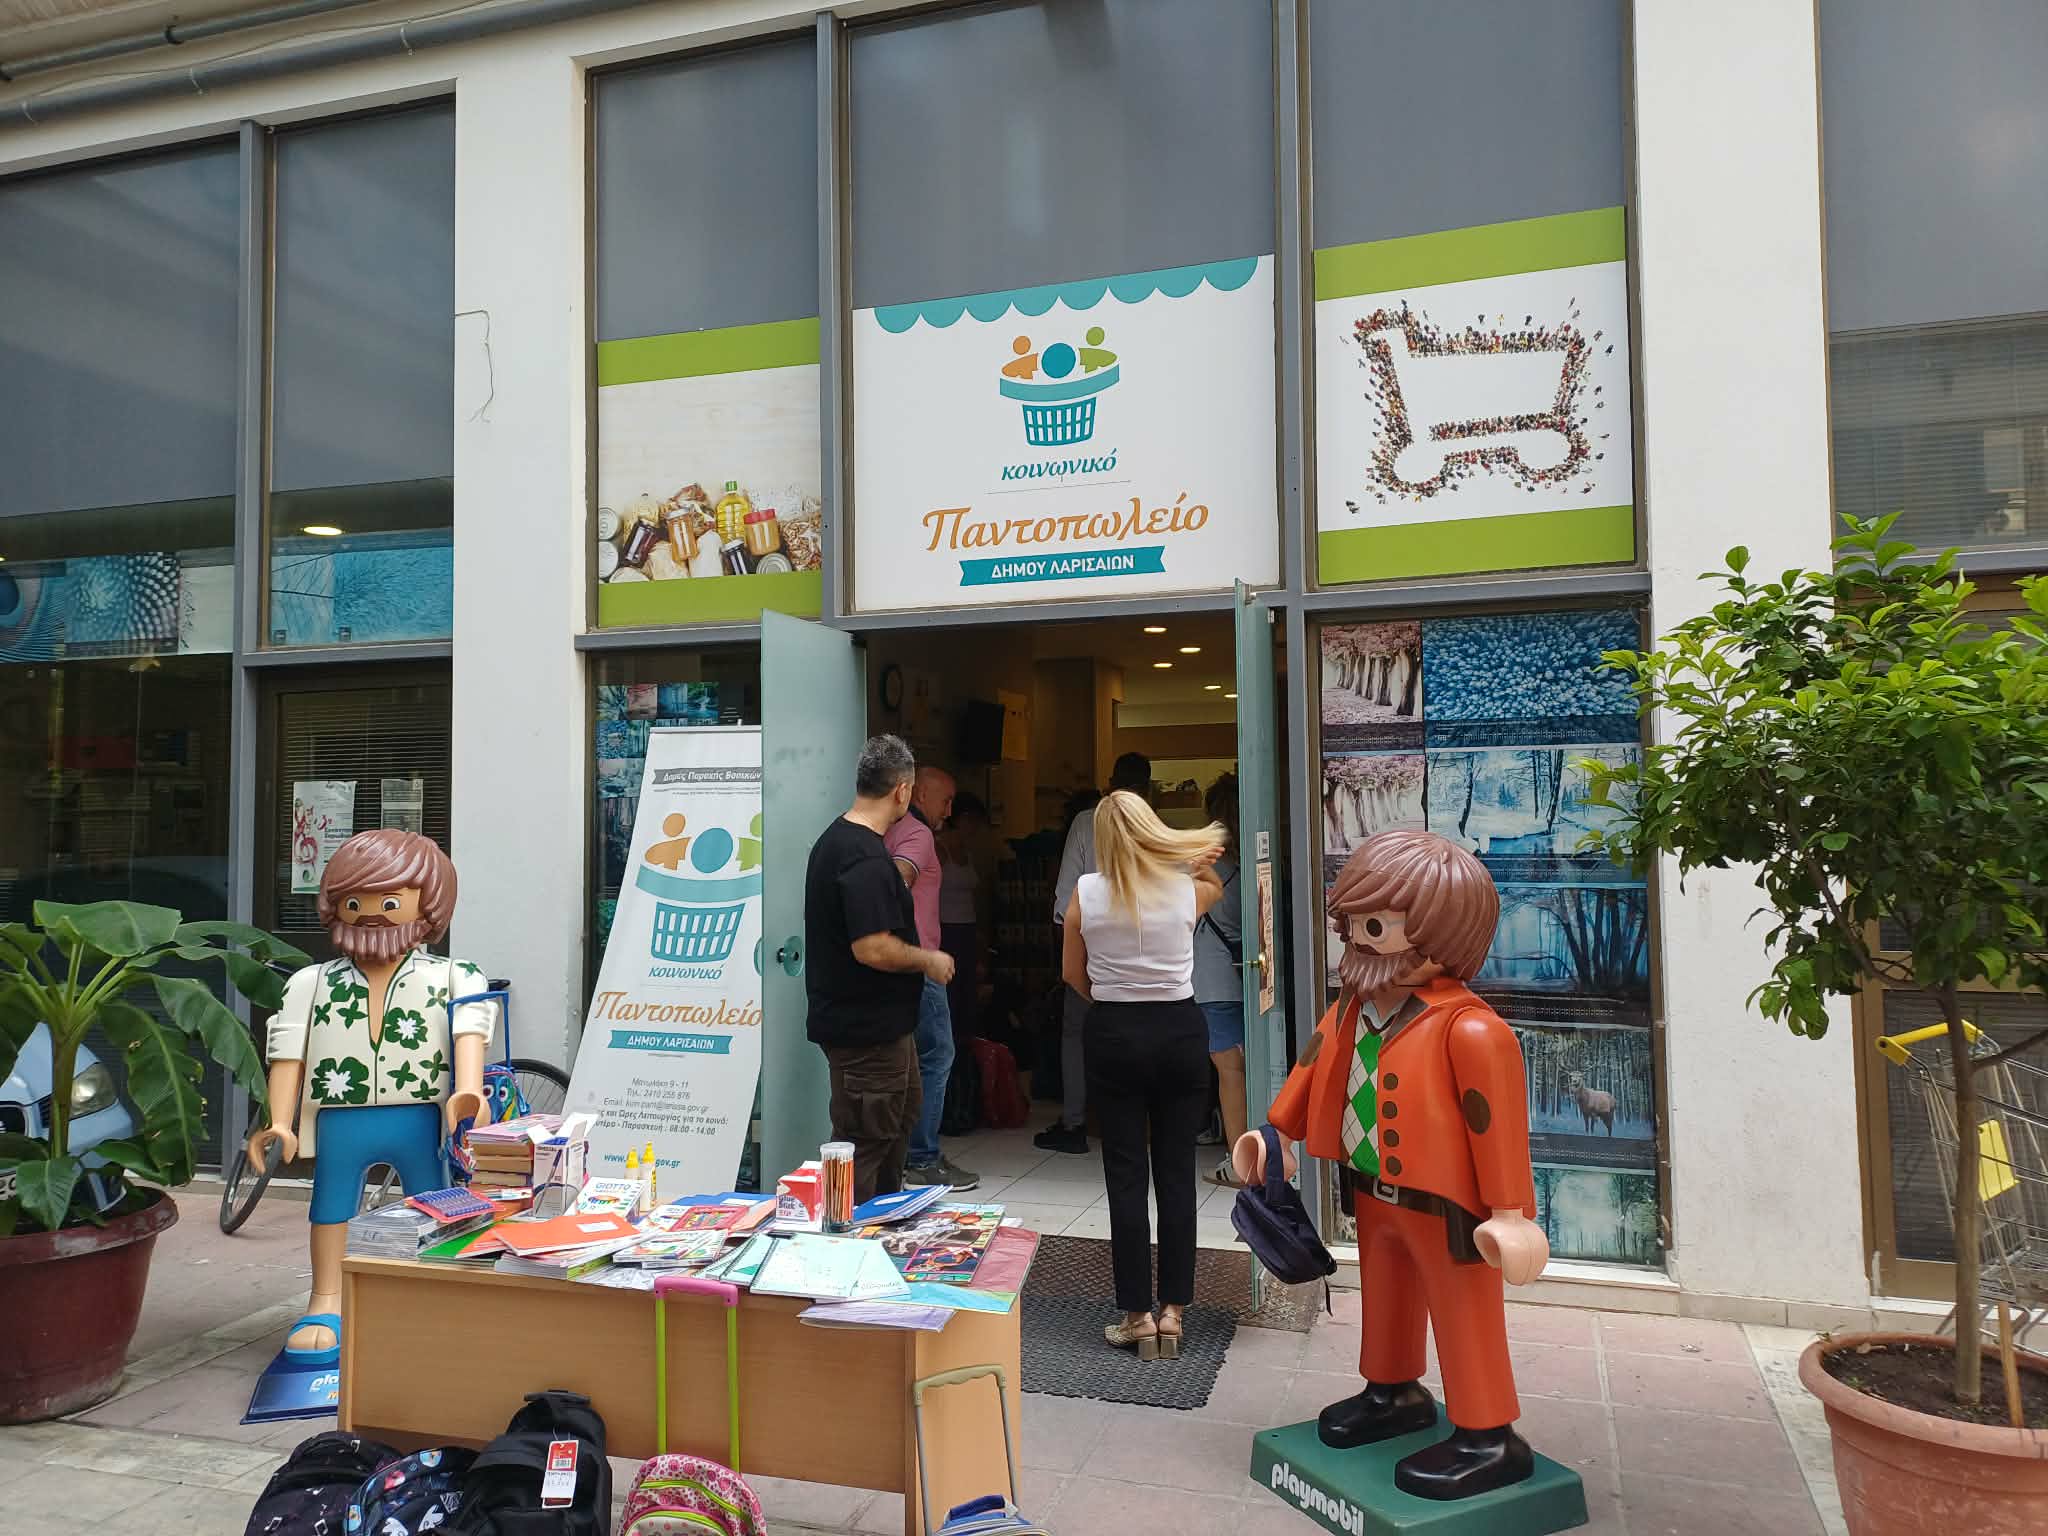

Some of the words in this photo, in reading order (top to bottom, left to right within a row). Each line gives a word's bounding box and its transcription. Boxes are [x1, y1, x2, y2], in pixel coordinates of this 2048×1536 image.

[1001, 448, 1117, 481] κοινωνικό
[922, 492, 1209, 551] Παντοπωλείο
[991, 559, 1046, 578] ΔΗΜΟΥ
[1050, 554, 1134, 575] ΛΑΡΙΣΑΙΩΝ
[648, 964, 724, 979] κοινωνικό
[595, 991, 762, 1028] Παντοπωλείο
[627, 1035, 662, 1047] ΔΗΜΟΥ
[663, 1037, 715, 1050] ΛΑΡΙΣΑΙΩΝ
[1271, 1462, 1364, 1536] playmobil
